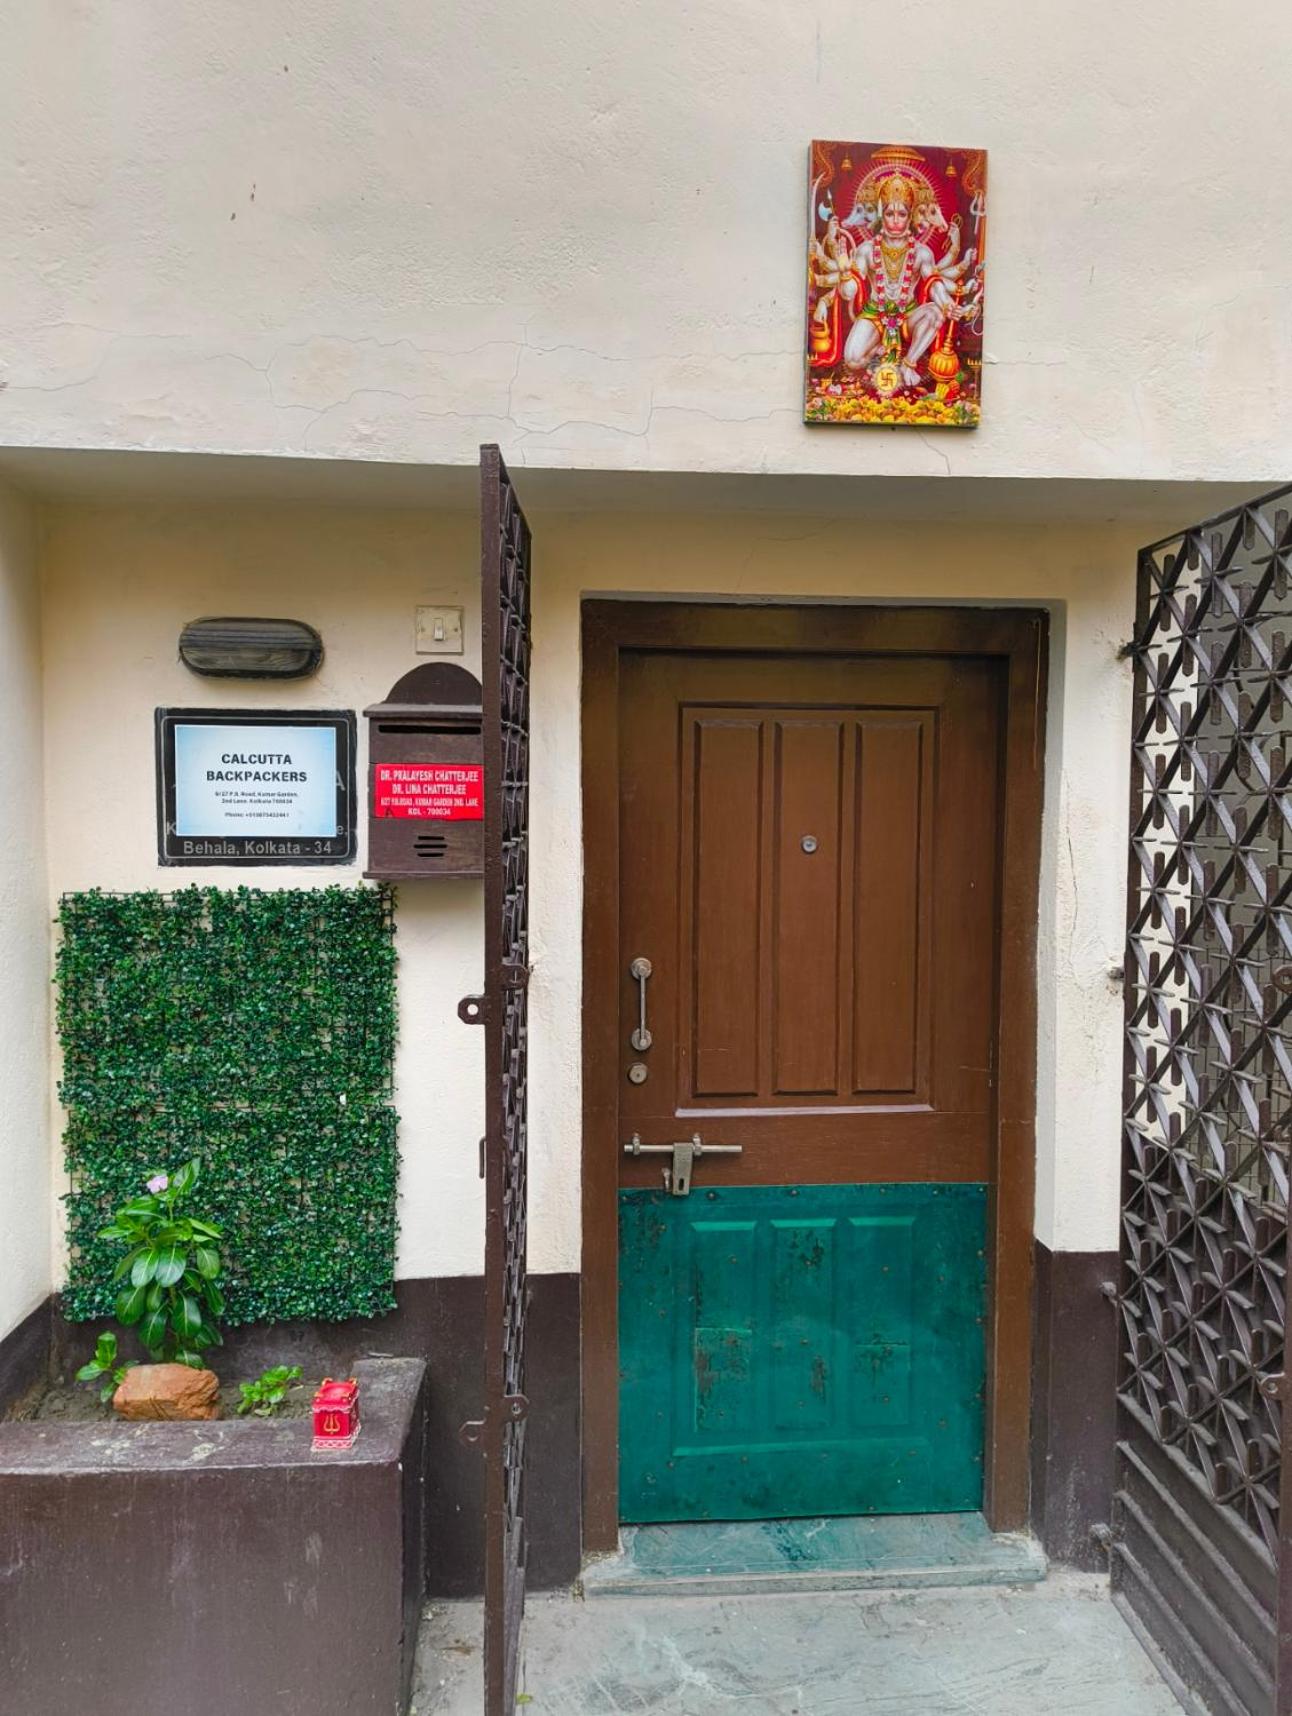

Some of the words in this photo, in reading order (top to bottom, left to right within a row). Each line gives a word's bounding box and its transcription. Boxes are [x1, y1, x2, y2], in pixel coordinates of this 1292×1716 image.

[221, 754, 292, 765] CALCUTTA
[206, 771, 307, 782] BACKPACKERS
[434, 771, 479, 783] CHATTERJEE
[423, 784, 467, 795] CHATTERJEE
[183, 840, 239, 855] Behala,
[245, 840, 301, 854] Kolkata
[314, 841, 332, 854] 34
